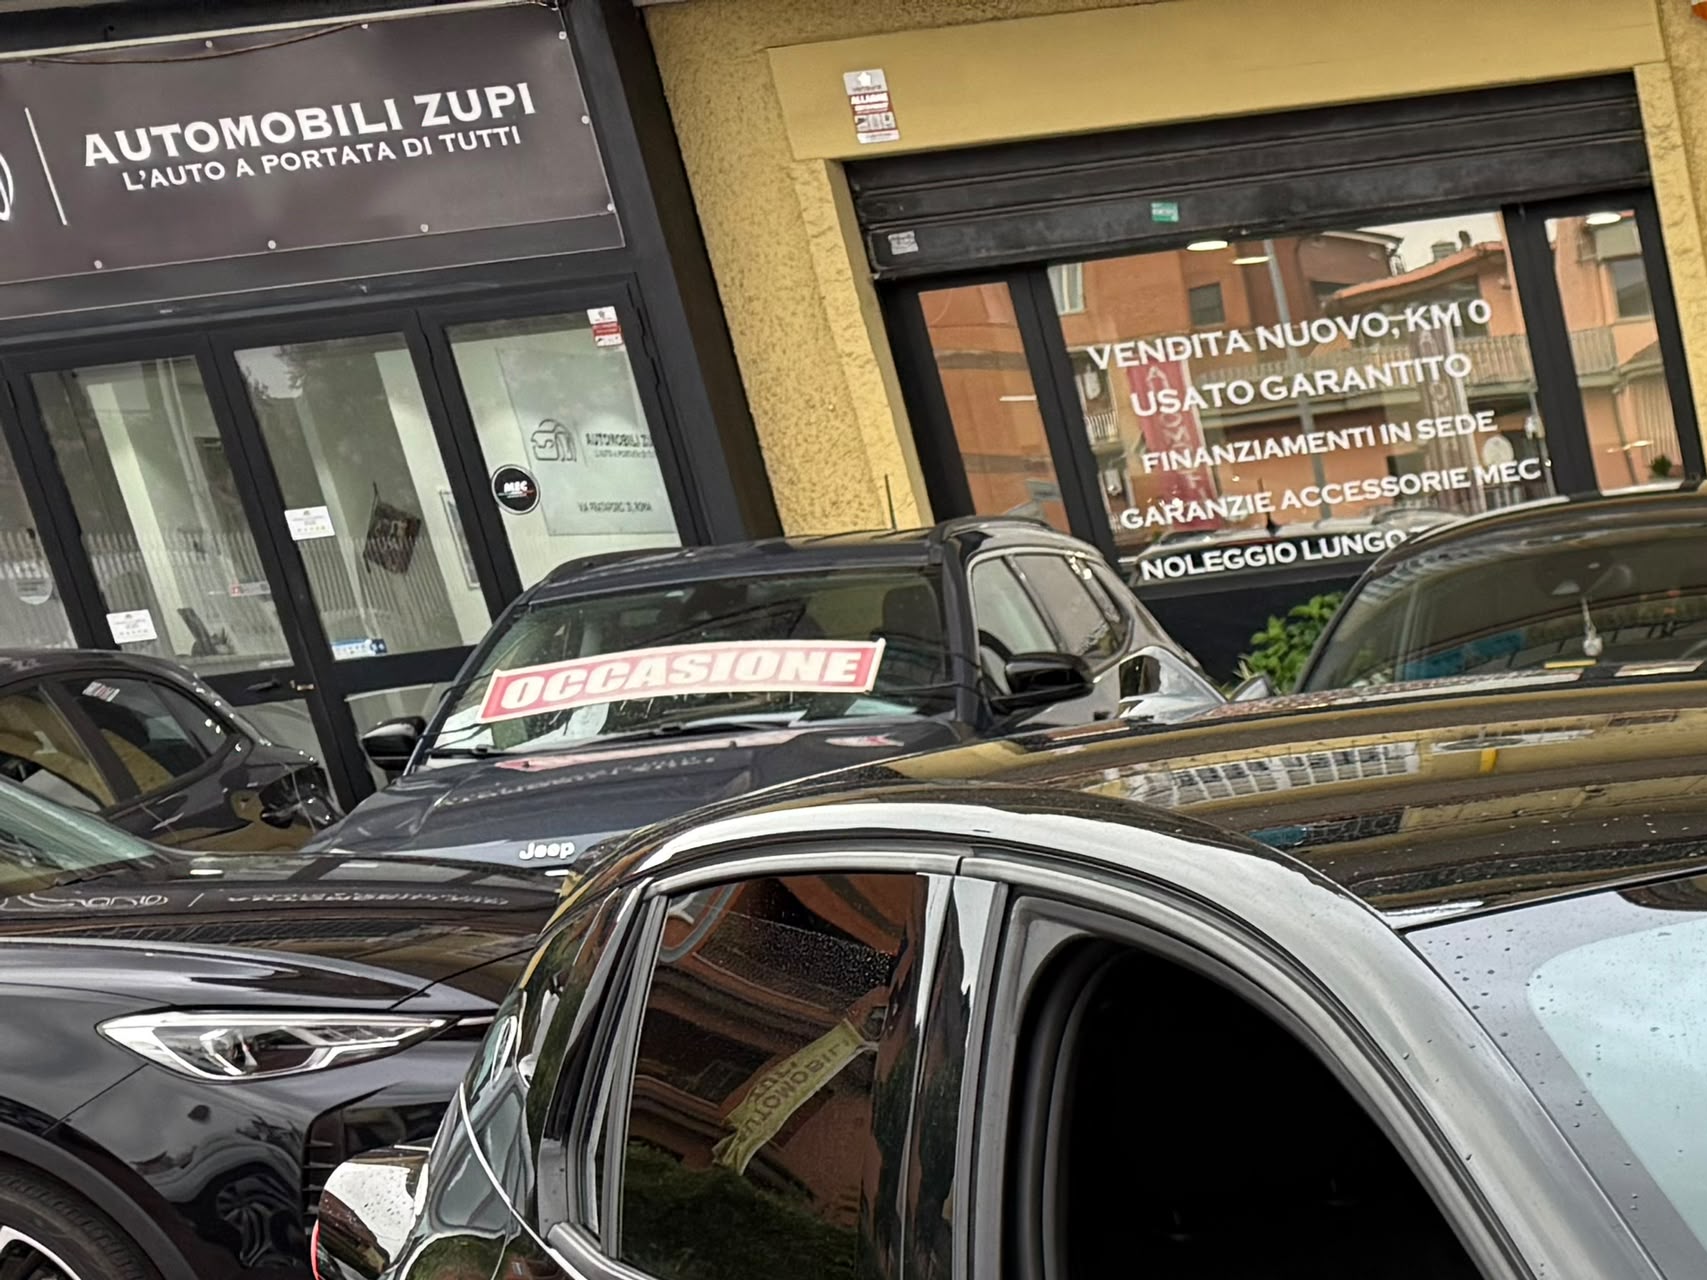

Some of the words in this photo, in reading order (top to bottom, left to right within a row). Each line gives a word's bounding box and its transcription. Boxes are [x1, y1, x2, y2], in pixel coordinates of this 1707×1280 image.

[84, 98, 403, 168] AUTOMOBILI
[412, 81, 537, 127] ZUPI
[122, 159, 226, 192] L'AUTO
[235, 157, 256, 178] A
[263, 140, 397, 175] PORTATA
[401, 135, 434, 158] DI
[438, 125, 522, 152] TUTTI
[1087, 330, 1252, 371] VENDITA
[1256, 310, 1401, 354] NUOVO,
[1404, 300, 1461, 333] KM
[1131, 379, 1255, 418] USATO
[1259, 352, 1473, 402] GARANTITO
[1141, 425, 1376, 475] FINANZIAMENTI
[1380, 420, 1413, 446] IN
[1416, 410, 1498, 441] SEDE
[1120, 490, 1276, 530] GARANZIE
[1280, 466, 1472, 510] ACCESSORIE
[1475, 457, 1544, 487] MEC
[1140, 540, 1298, 582] NOLEGGIO
[1302, 529, 1408, 563] LUNGO
[499, 649, 862, 711] OCCASIONE
[519, 842, 575, 860] Jeep
